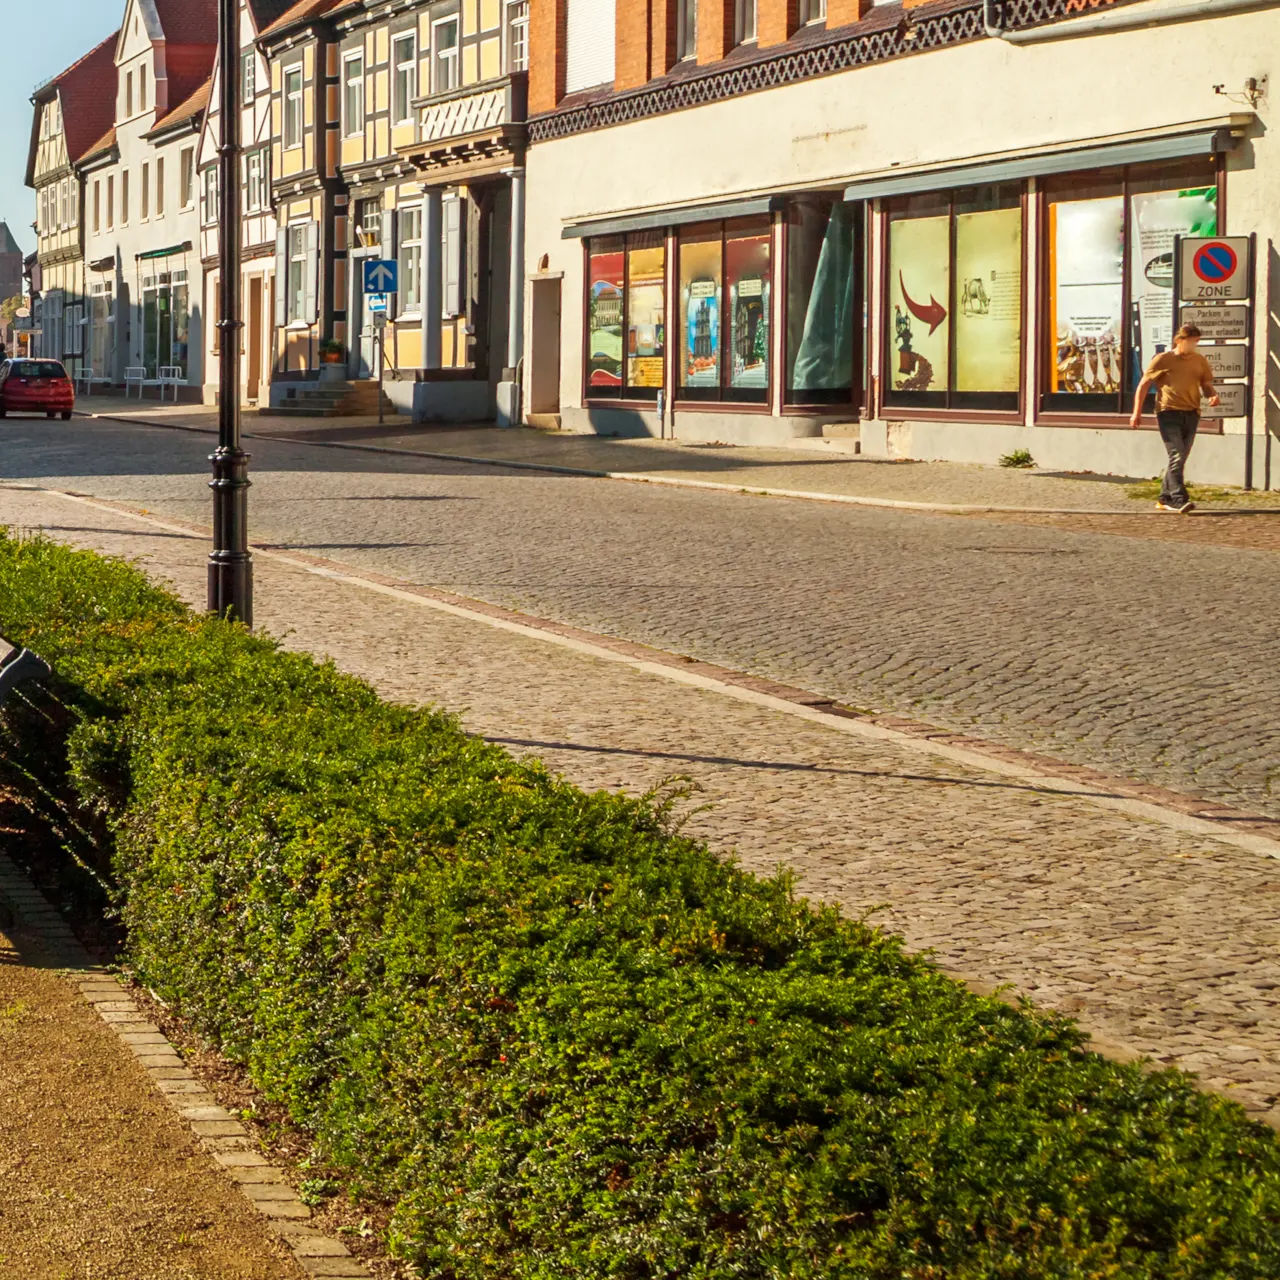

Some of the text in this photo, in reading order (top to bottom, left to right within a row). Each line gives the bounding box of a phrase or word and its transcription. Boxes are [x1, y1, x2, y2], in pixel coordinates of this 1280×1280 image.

[1197, 286, 1232, 297] ZONE
[1197, 308, 1231, 318] Parken in
[1215, 328, 1241, 336] erlaubt
[1205, 352, 1222, 361] mit
